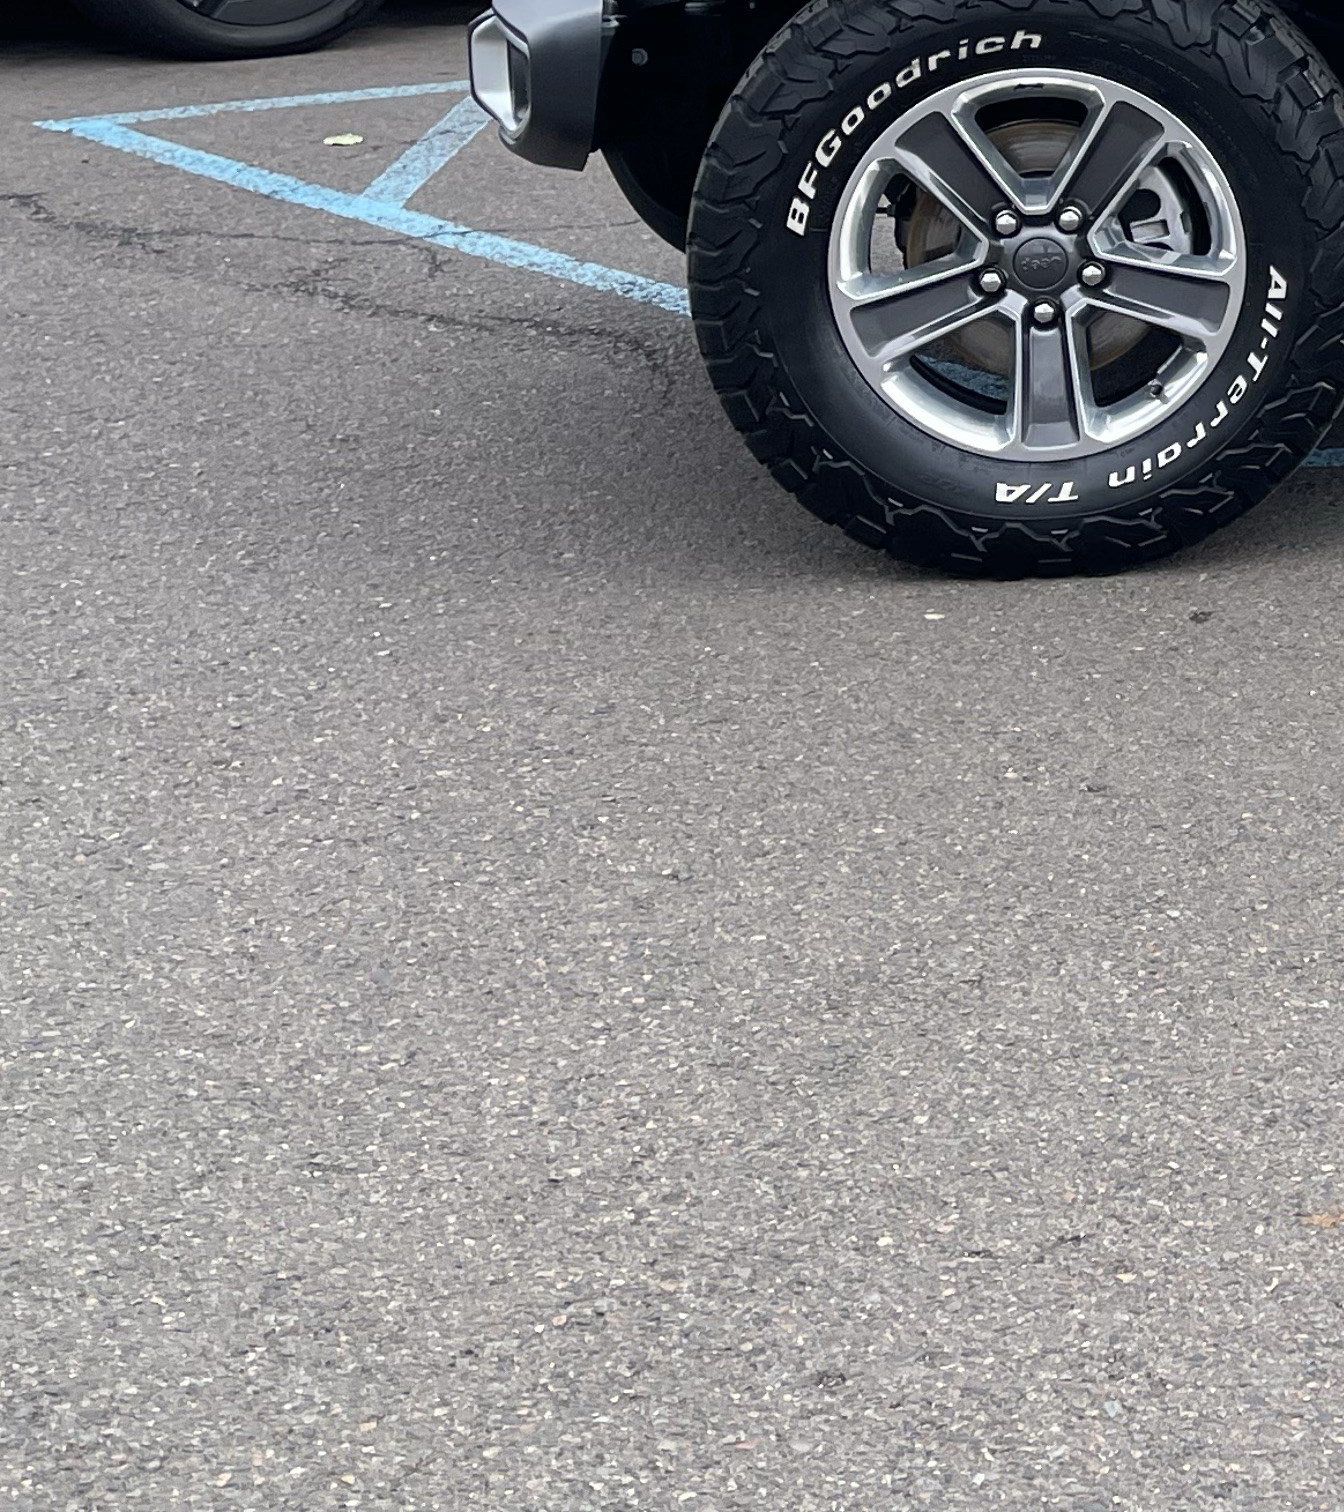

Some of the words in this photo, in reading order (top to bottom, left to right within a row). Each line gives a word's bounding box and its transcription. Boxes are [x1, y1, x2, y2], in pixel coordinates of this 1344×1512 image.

[785, 28, 1044, 238] BFGoodrich
[1107, 264, 1289, 490] All-Terrain
[995, 480, 1081, 504] T/A
